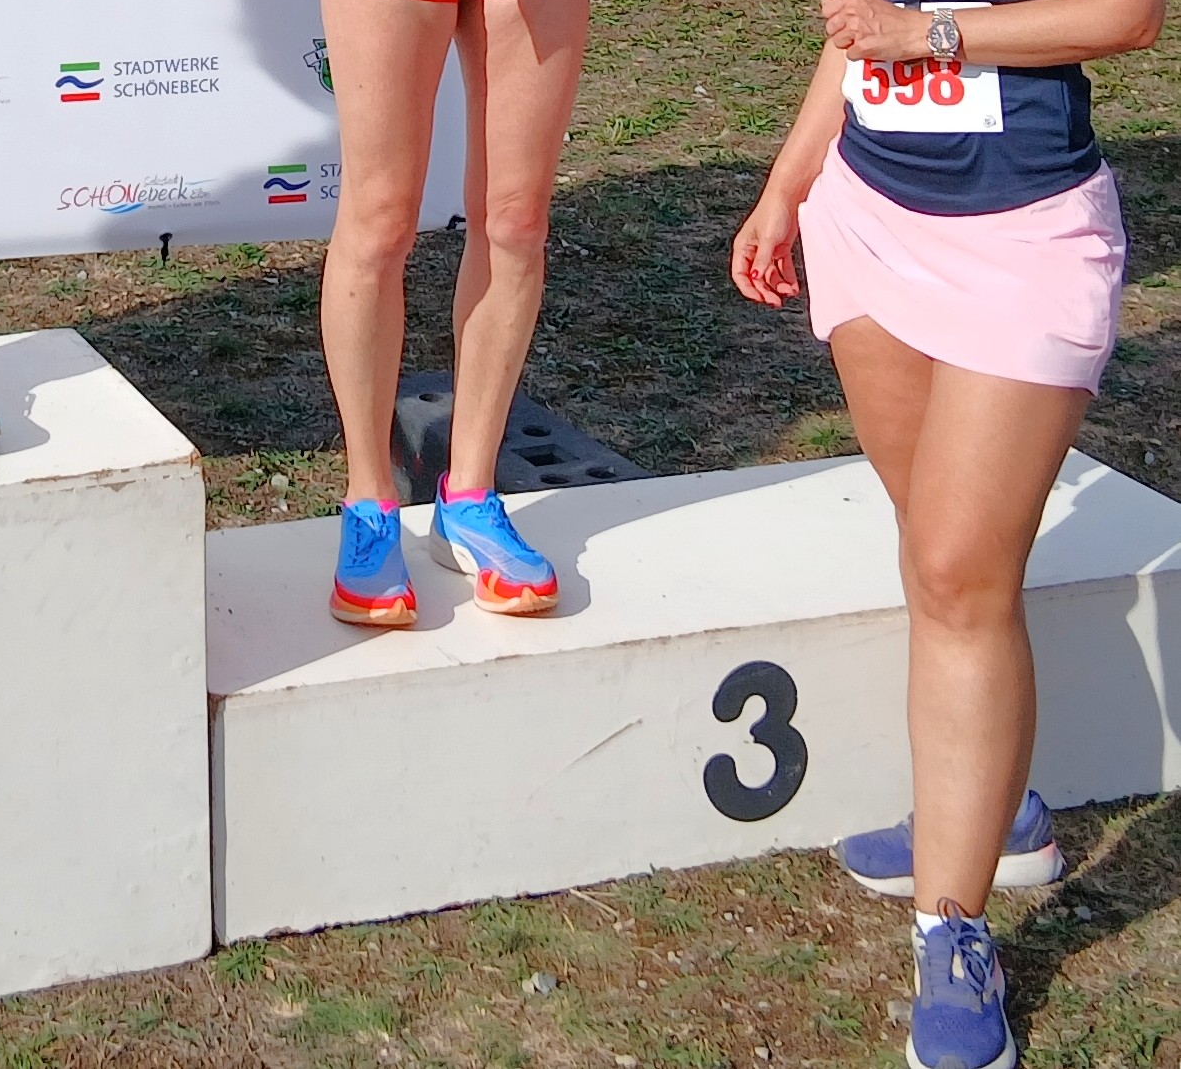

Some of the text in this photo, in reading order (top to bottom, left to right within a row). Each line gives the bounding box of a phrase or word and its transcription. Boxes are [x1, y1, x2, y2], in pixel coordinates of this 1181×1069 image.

[114, 57, 219, 76] STADTWERKE
[862, 58, 965, 106] 598
[114, 78, 219, 97] SCHÖNEBECK
[57, 177, 189, 211] SCHÖNebeck
[702, 659, 808, 823] 3
